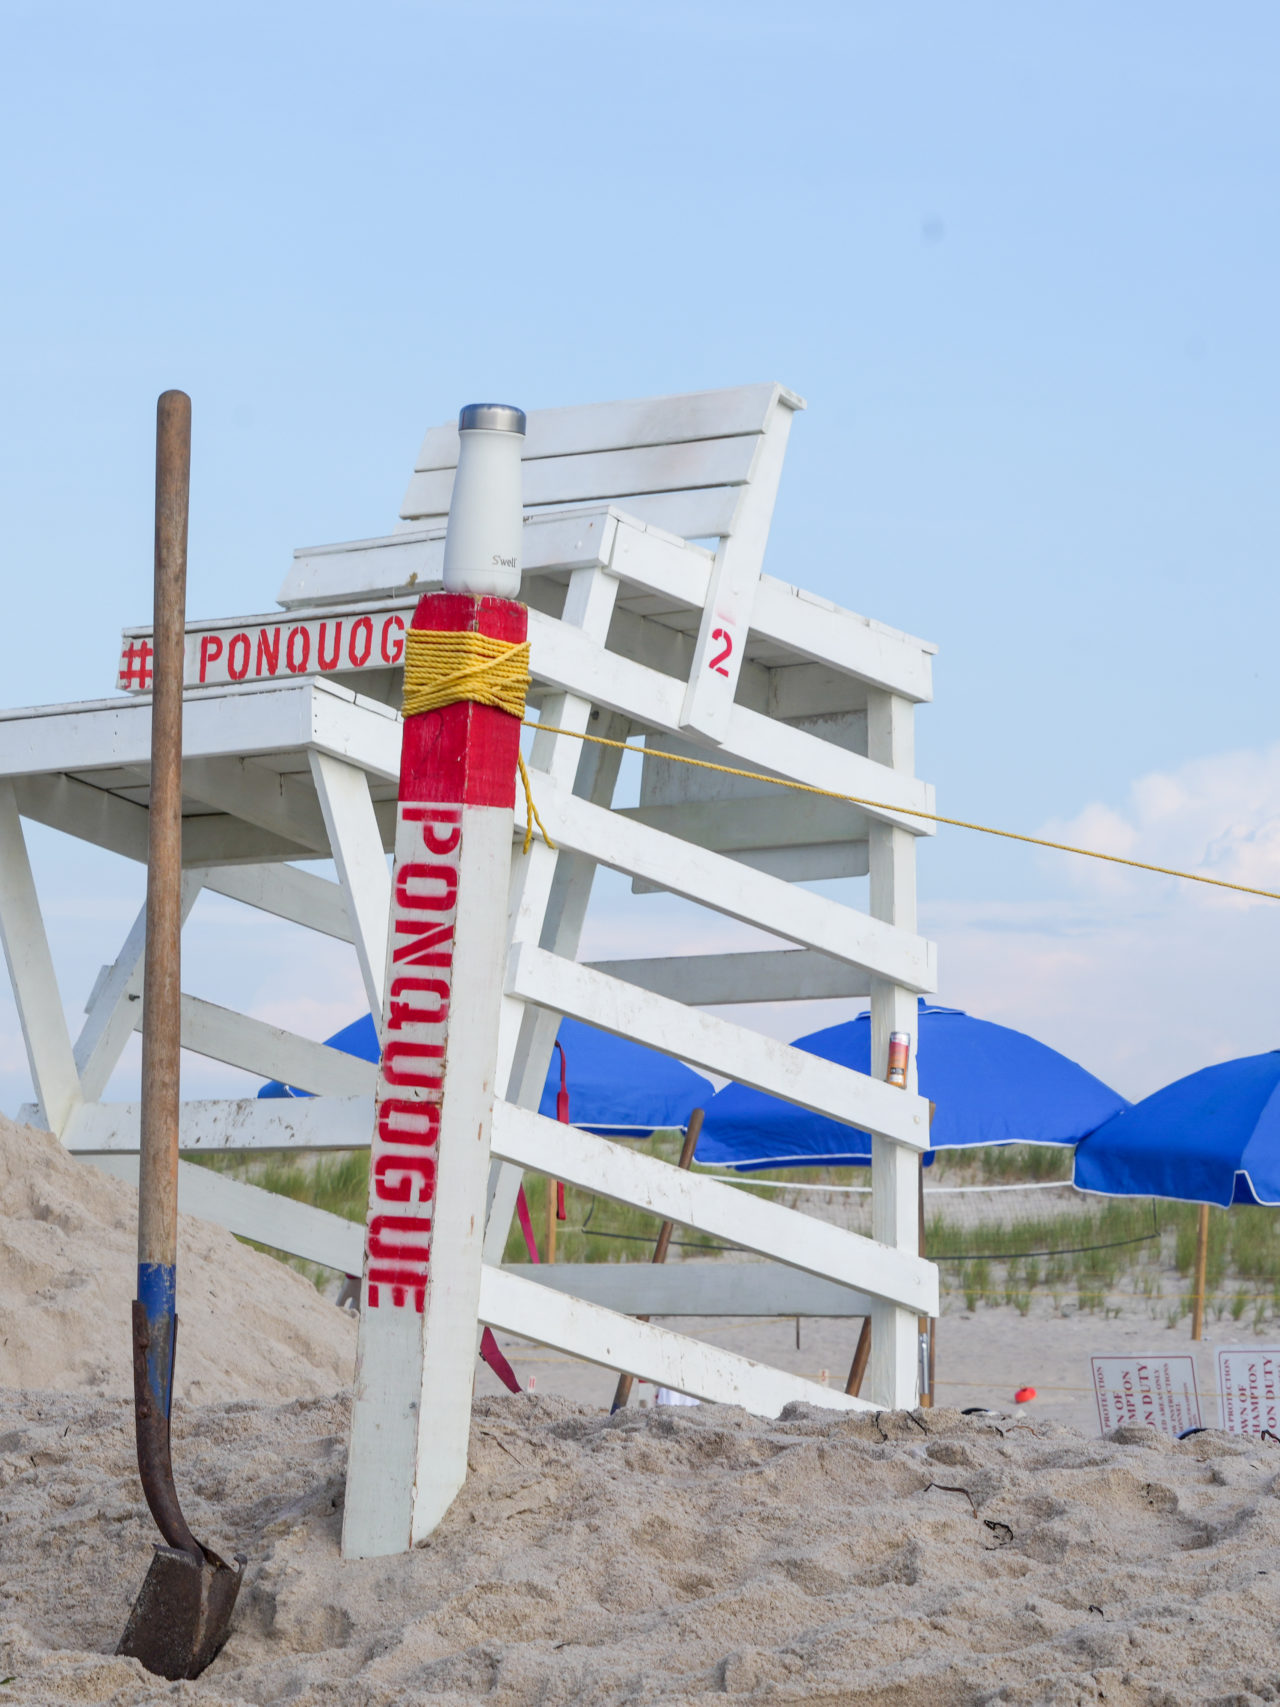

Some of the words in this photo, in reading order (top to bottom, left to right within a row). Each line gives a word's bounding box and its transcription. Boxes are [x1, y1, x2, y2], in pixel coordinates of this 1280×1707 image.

[708, 628, 732, 678] 2
[368, 808, 461, 1314] PONQUOGUE
[1097, 1366, 1111, 1429] PROTECTION
[1136, 1363, 1153, 1405] DUTY
[1224, 1360, 1234, 1422] PROTECTION
[1263, 1356, 1276, 1401] DUTY
[1266, 1405, 1277, 1429] ON
